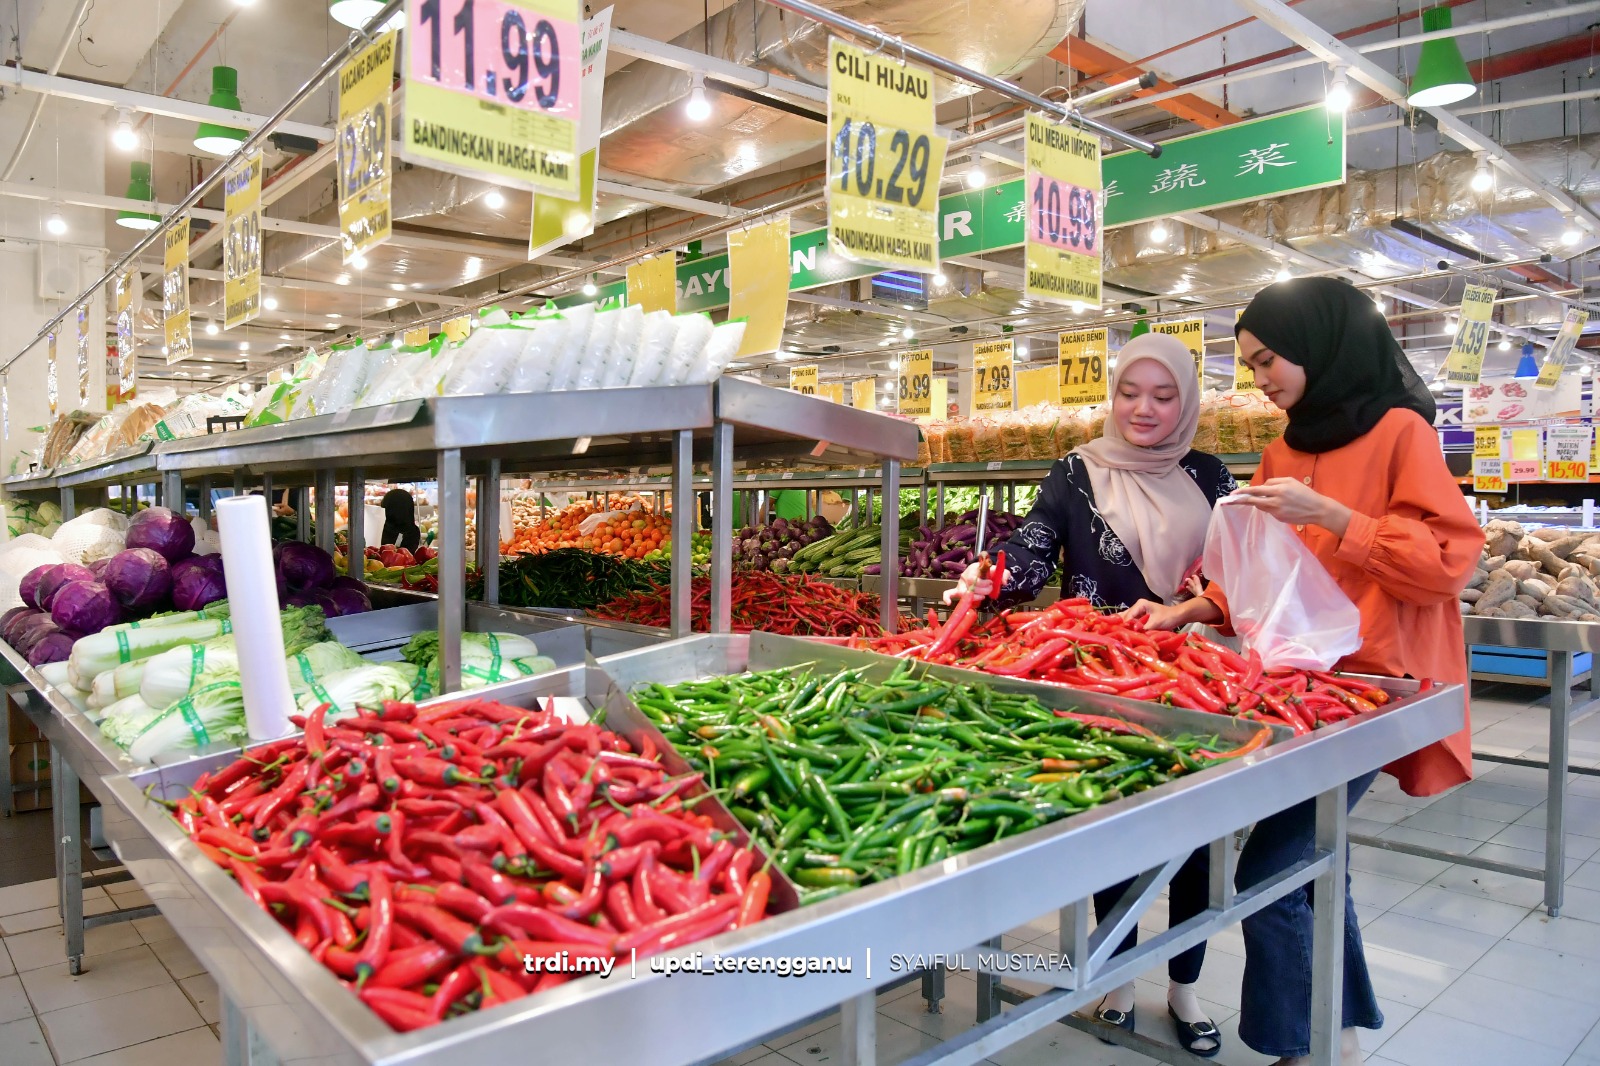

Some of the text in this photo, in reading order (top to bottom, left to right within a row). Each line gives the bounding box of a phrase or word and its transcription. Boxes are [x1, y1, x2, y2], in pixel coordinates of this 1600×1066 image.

[341, 38, 392, 96] KACANG BUNCIS
[419, 0, 561, 110] 11.99
[835, 50, 929, 101] CILI HIJAU
[836, 92, 852, 106] RM
[412, 118, 495, 164] BANDINGKAN
[497, 141, 538, 175] HARGA
[540, 152, 569, 181] KAMI
[1028, 121, 1097, 162] CILI MERAH IMPORT
[834, 116, 932, 209] 10.29
[1033, 176, 1096, 252] 10.99
[834, 226, 932, 263] BANDINGKAN HARGA KAMI
[1029, 271, 1098, 299] BANDINGKAN HARGA KAMI
[1060, 331, 1105, 345] KACANG BENDI
[1182, 322, 1200, 333] AIR
[1454, 319, 1486, 356] 4.59
[899, 373, 931, 400] 8.99
[976, 364, 1011, 393] 7.99
[1061, 355, 1102, 385] 7.79
[1514, 467, 1535, 475] 29.99
